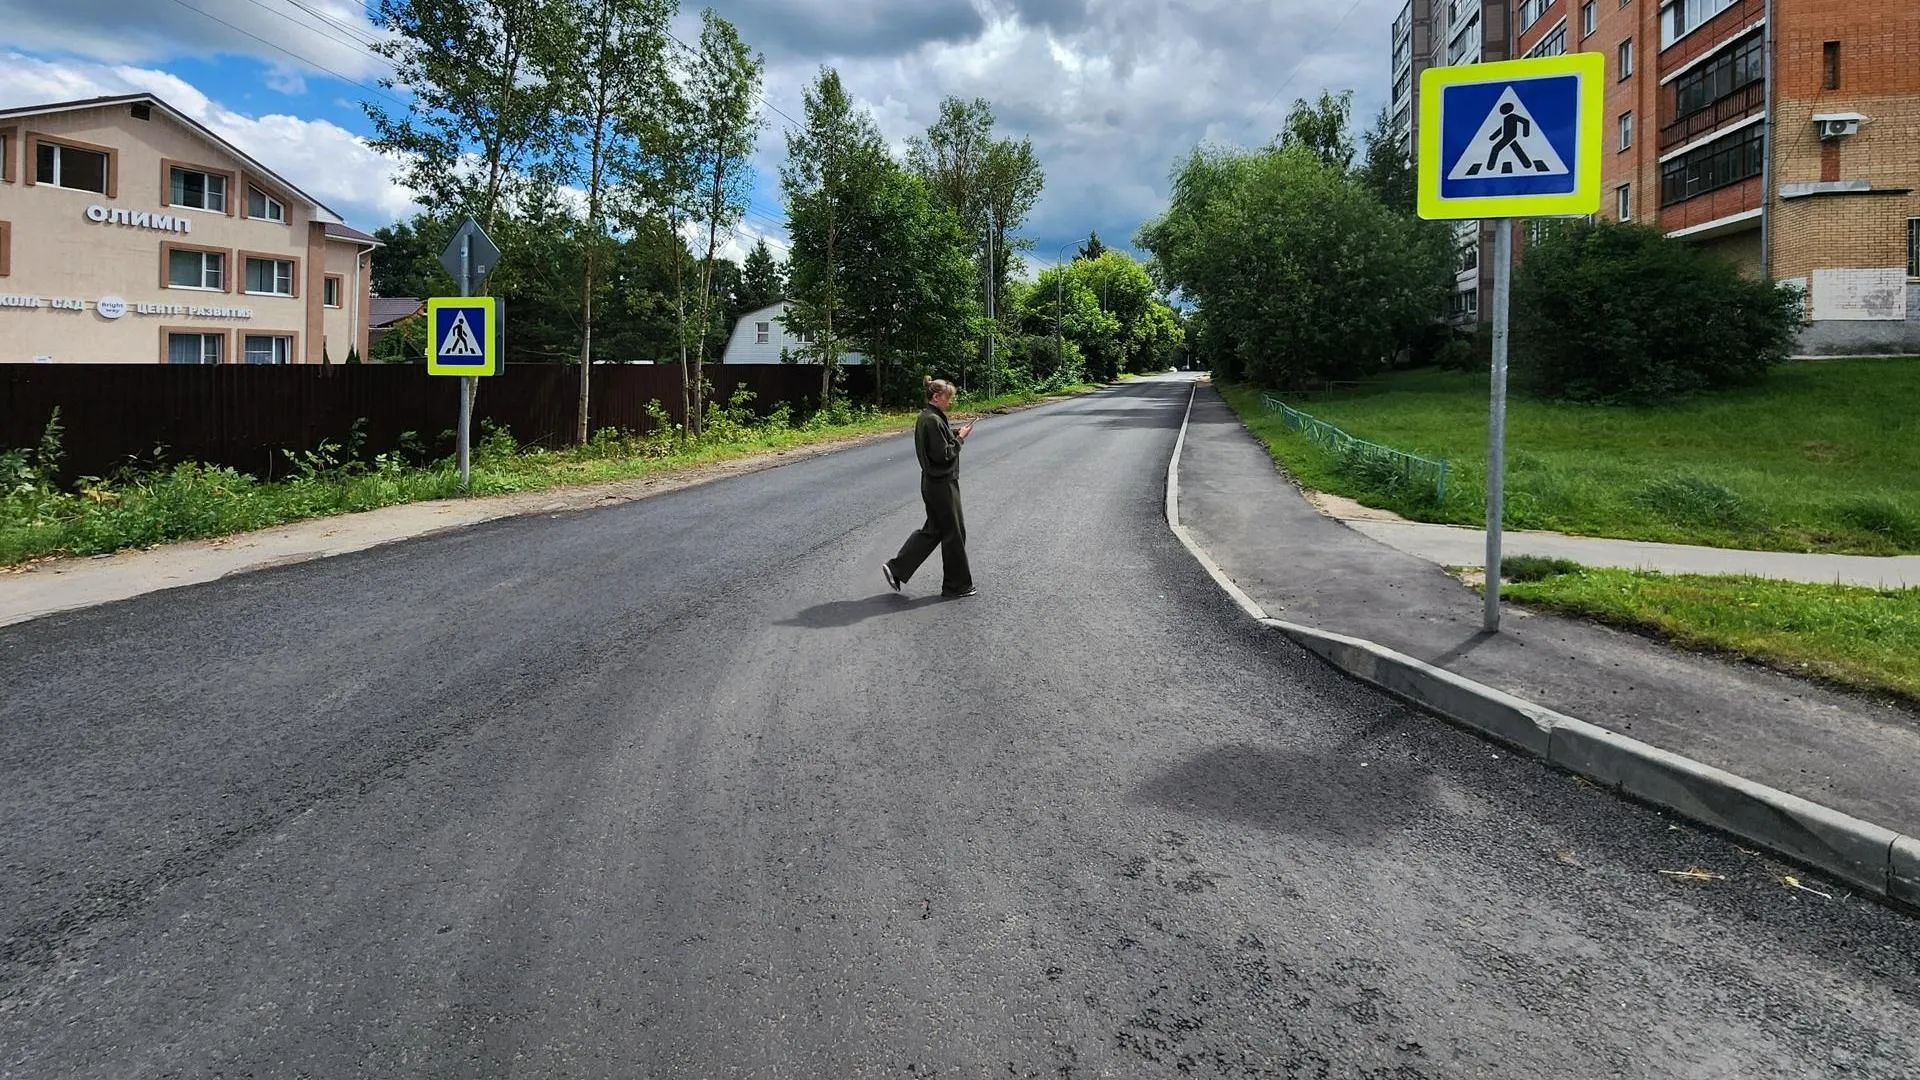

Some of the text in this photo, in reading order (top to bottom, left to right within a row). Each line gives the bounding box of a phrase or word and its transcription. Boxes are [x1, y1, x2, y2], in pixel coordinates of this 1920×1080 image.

[86, 204, 192, 233] ОЛИМП
[52, 297, 86, 311] САД
[137, 303, 253, 319] ЦЕНТР РАЗВИТИЯ
